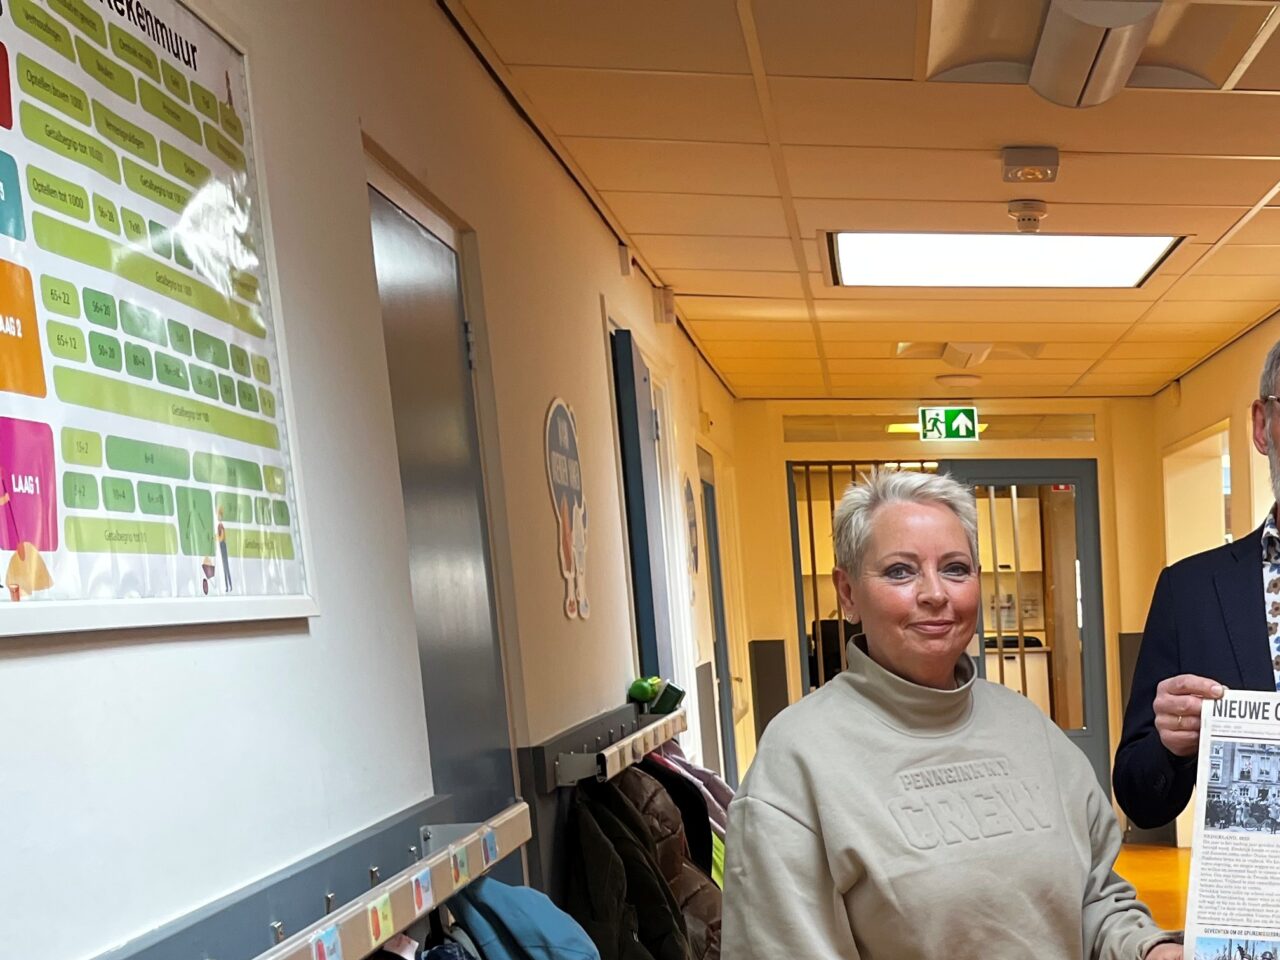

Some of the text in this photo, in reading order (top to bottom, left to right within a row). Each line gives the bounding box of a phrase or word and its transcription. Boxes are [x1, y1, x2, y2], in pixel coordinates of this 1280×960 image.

[103, 0, 197, 71] ekenmuur
[12, 474, 40, 495] LAAG 1
[1212, 699, 1271, 721] NIEUWE
[888, 780, 1053, 850] CREW
